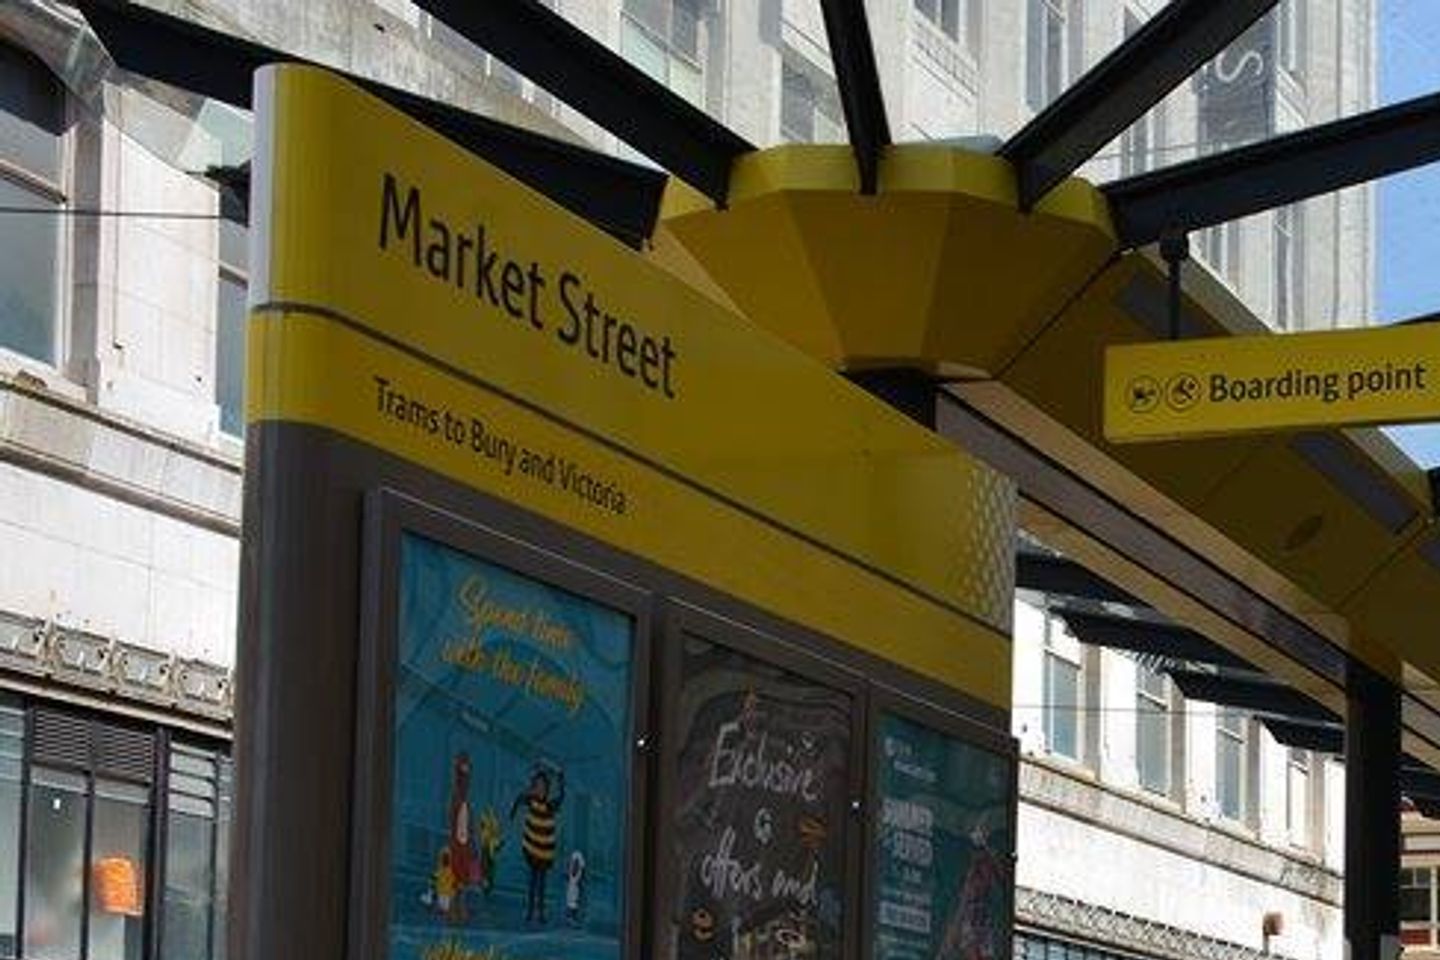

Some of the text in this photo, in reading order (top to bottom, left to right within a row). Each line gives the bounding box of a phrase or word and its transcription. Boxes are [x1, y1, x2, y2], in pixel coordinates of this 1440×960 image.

[378, 172, 677, 400] Market Street
[1208, 361, 1427, 404] Boarding point
[373, 374, 628, 515] Trams to Bury and Victoria
[700, 825, 819, 907] offers and
